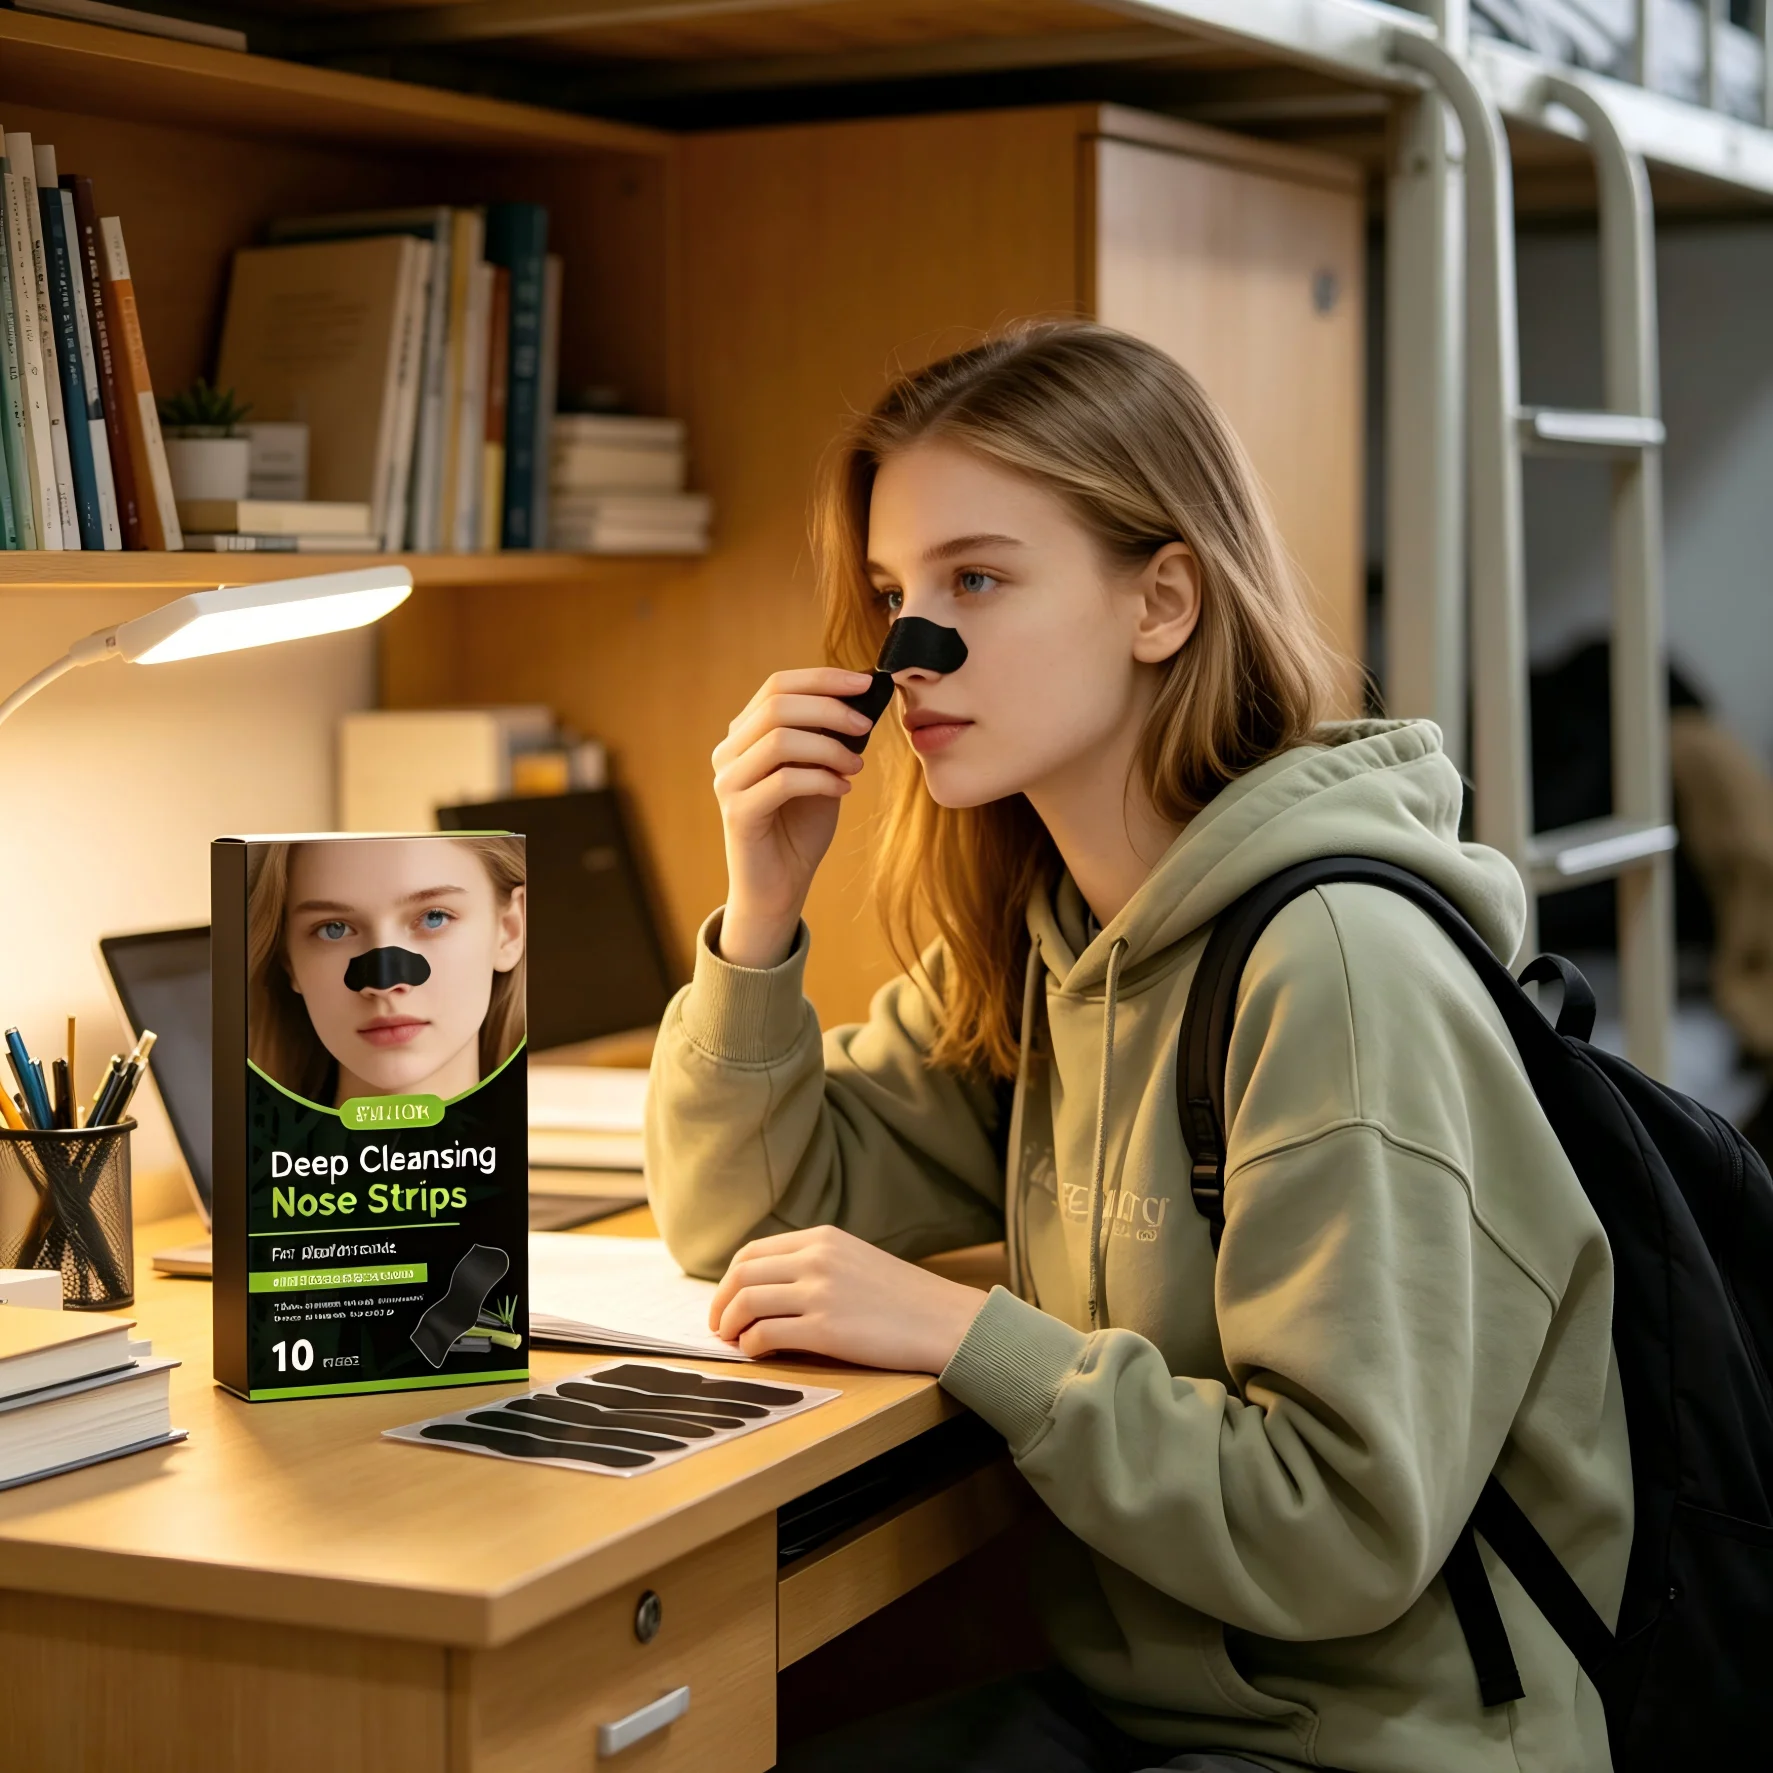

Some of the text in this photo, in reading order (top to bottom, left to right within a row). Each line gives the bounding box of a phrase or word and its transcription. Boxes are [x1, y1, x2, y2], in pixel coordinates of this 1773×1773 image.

[271, 1140, 496, 1185] Deep Cleansing
[272, 1180, 467, 1219] Nose Strips
[271, 1338, 314, 1372] 10
